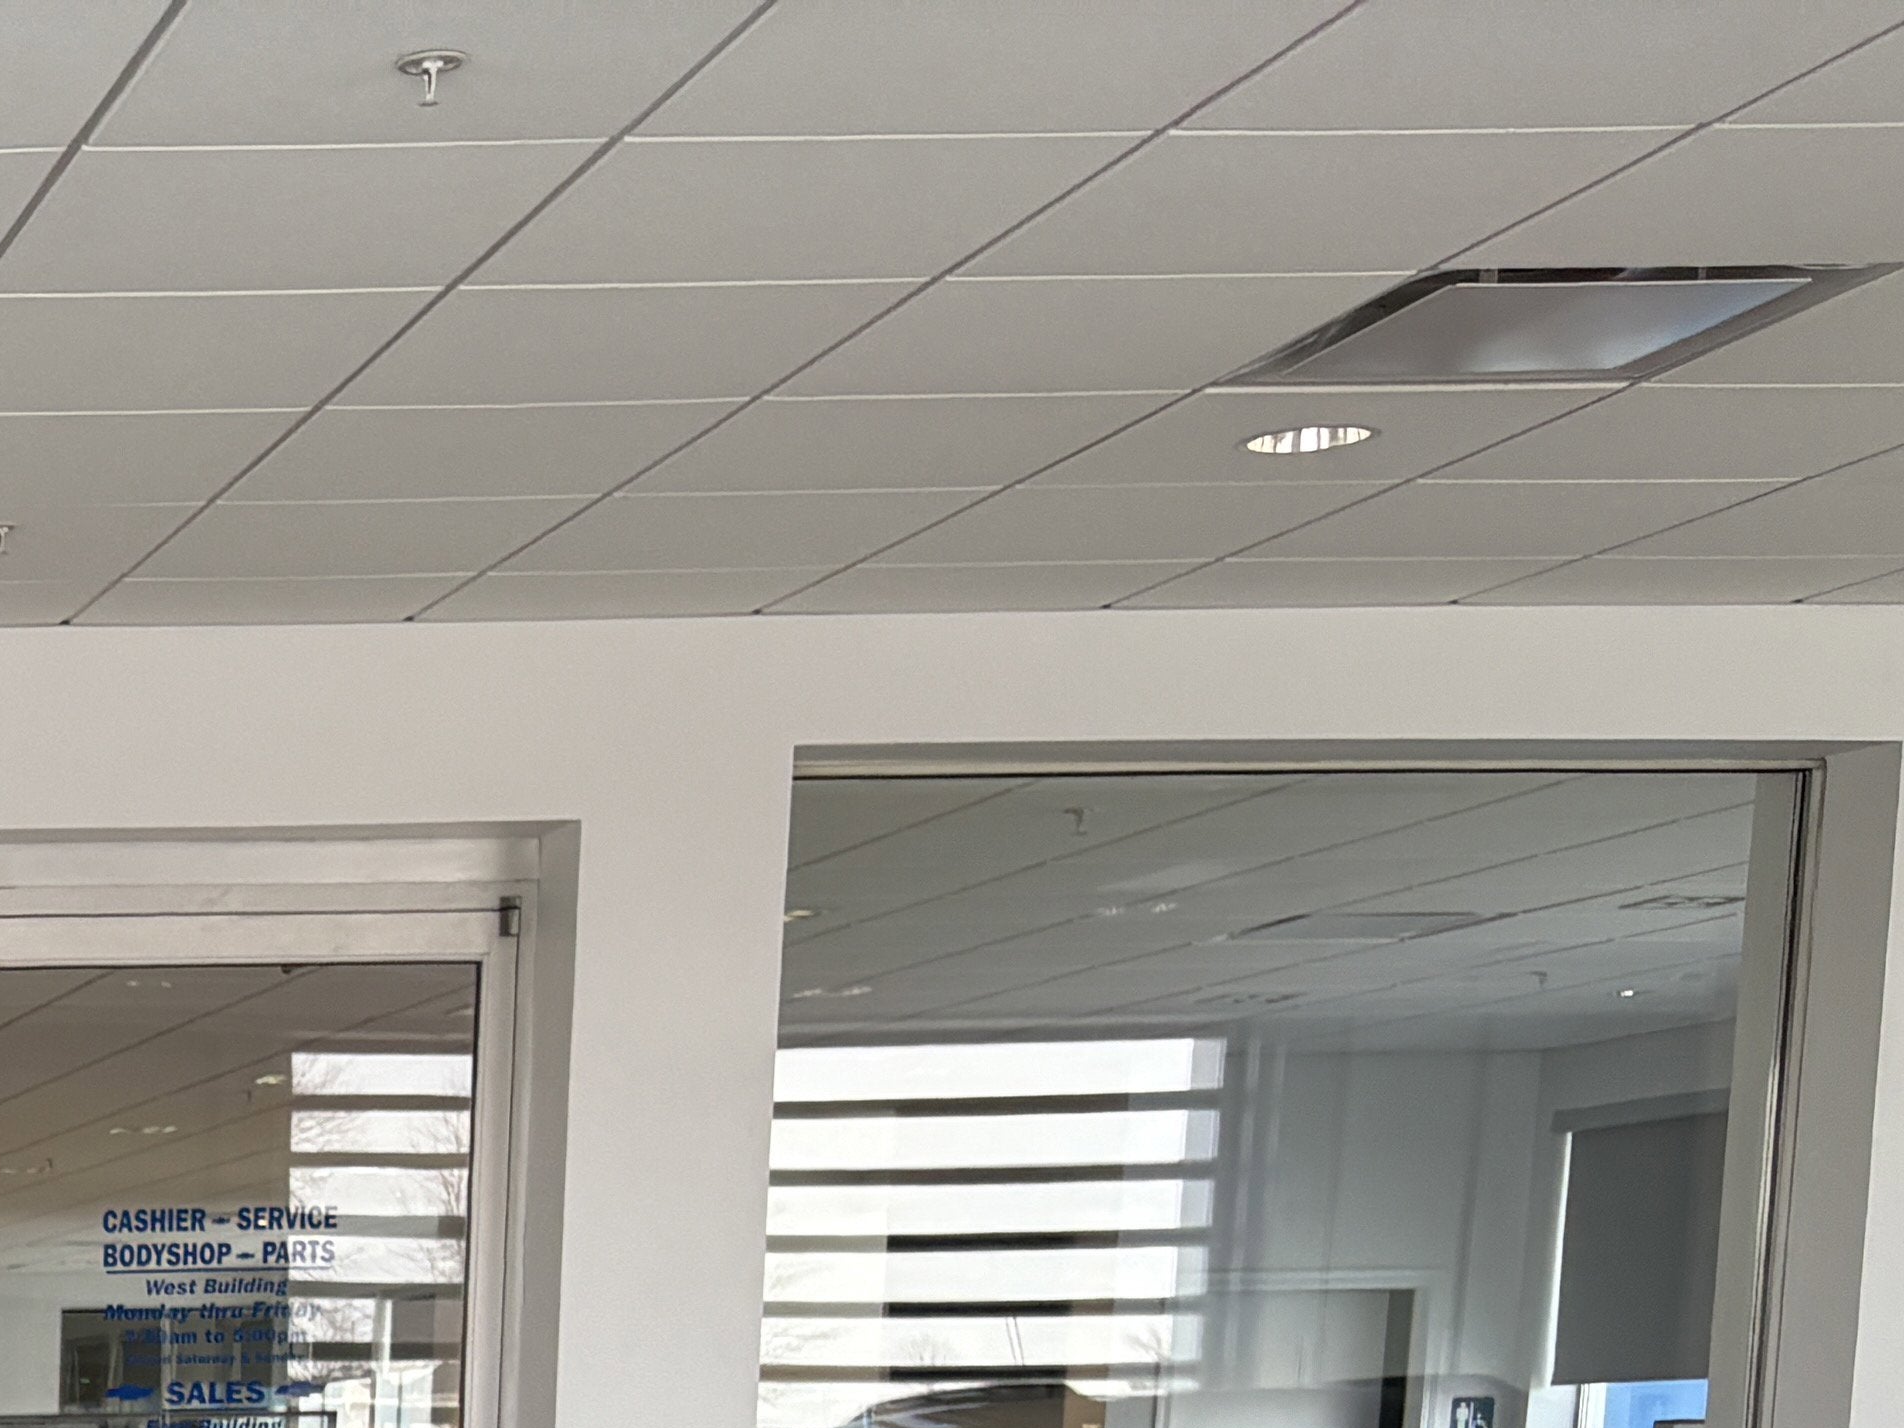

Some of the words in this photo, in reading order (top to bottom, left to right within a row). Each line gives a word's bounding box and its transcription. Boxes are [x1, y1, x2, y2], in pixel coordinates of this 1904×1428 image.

[103, 1208, 206, 1233] CASHIER
[237, 1206, 338, 1230] SERVICE
[103, 1242, 232, 1268] BODYSHOP
[262, 1240, 336, 1264] PARTS
[146, 1280, 196, 1295] West
[204, 1278, 288, 1296] Building
[200, 1303, 243, 1319] thru
[205, 1329, 224, 1343] to
[167, 1381, 267, 1404] SALES
